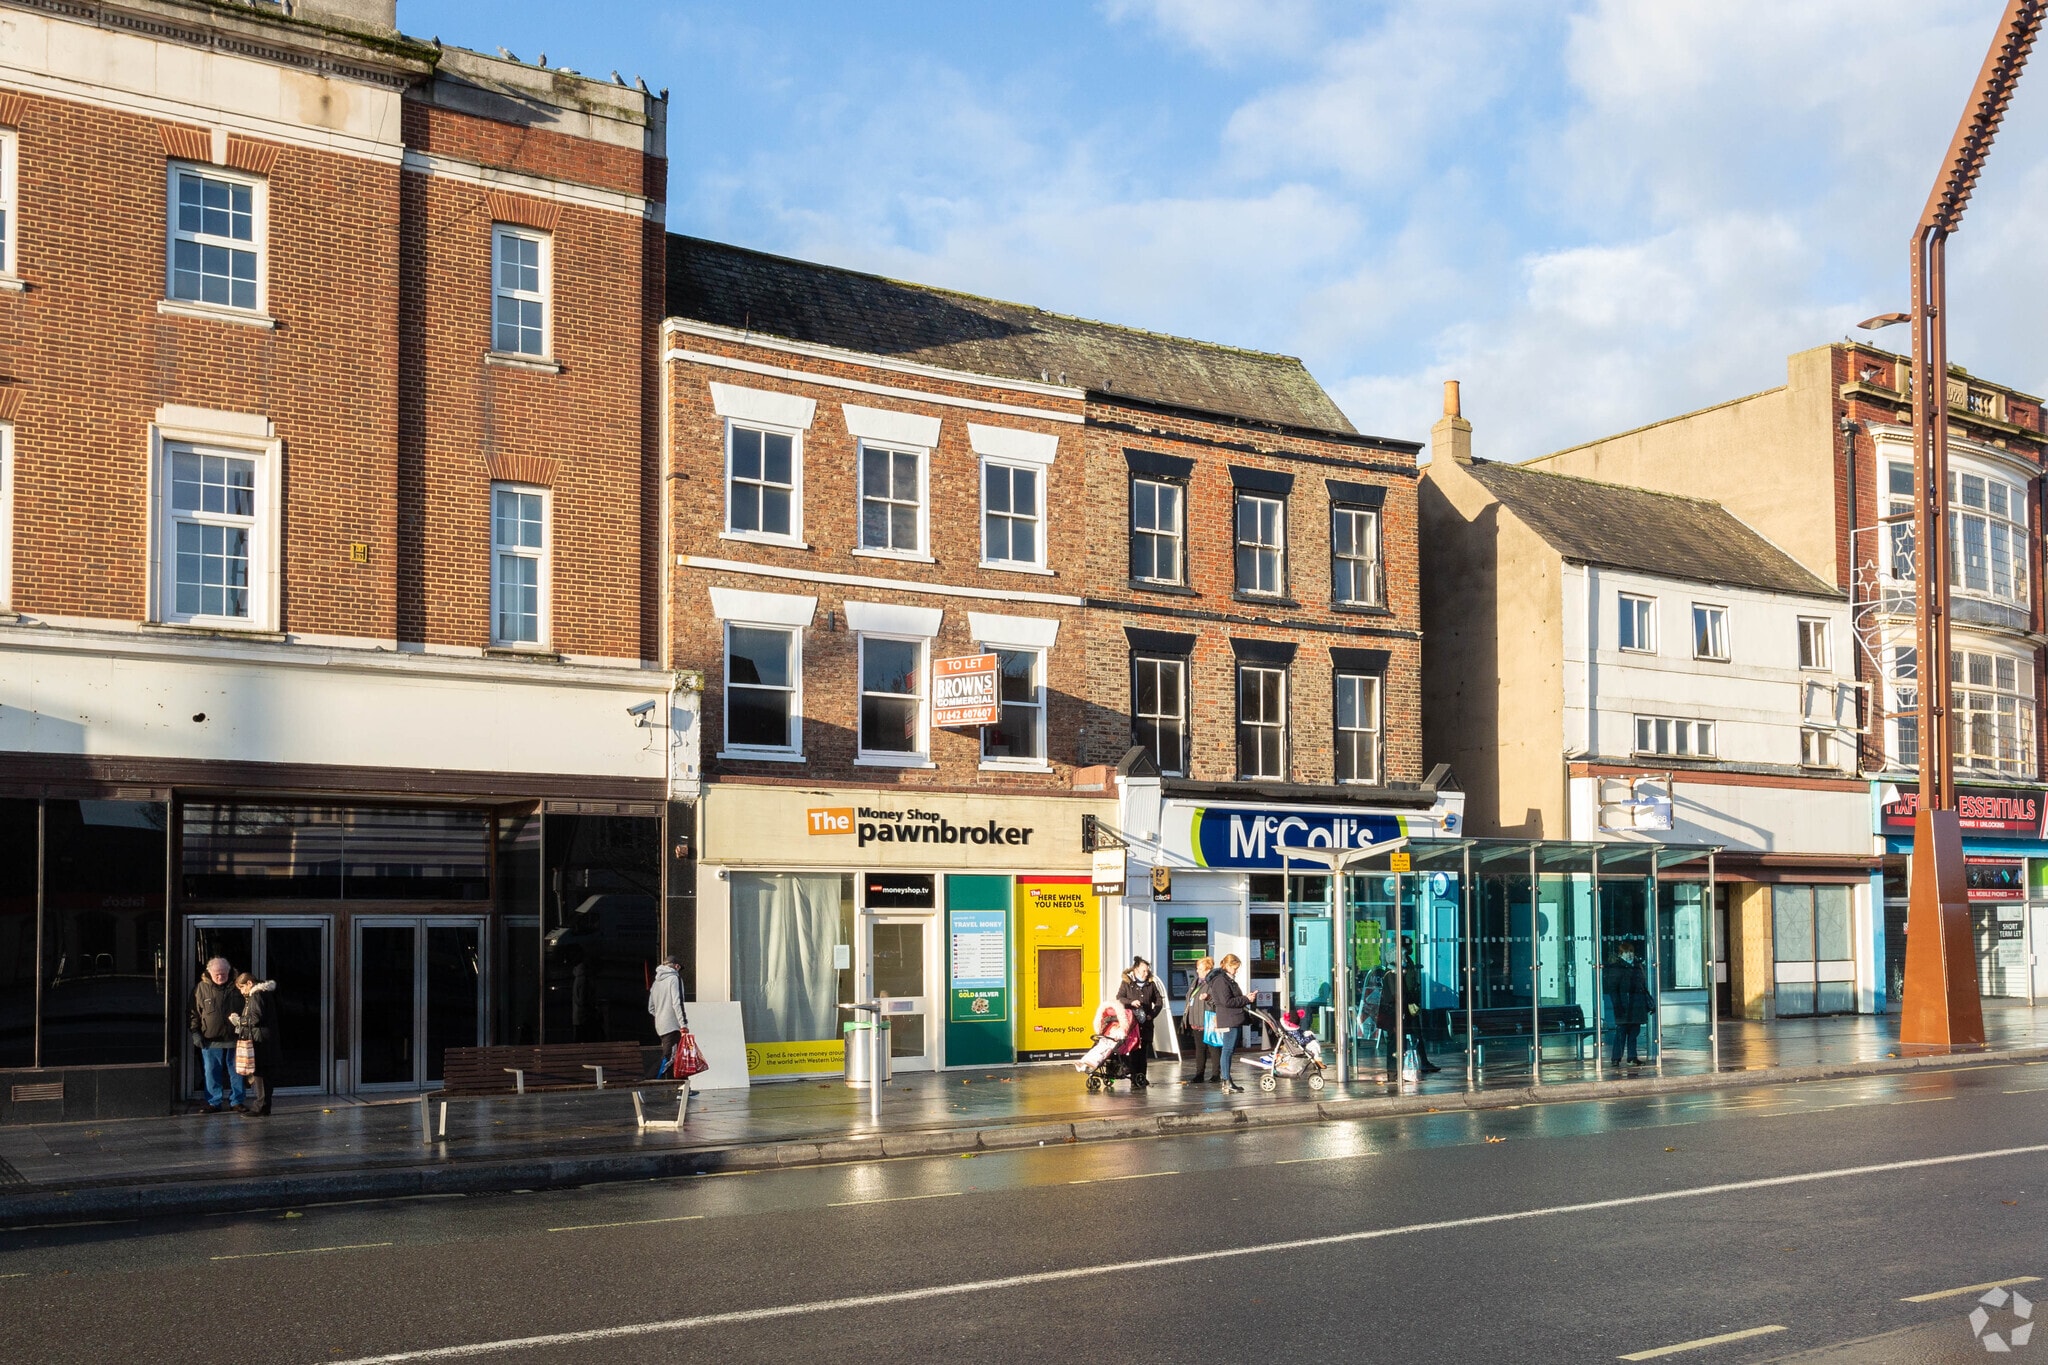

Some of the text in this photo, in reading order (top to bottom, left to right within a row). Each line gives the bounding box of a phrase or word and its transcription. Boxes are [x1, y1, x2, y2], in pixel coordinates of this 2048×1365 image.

[1947, 384, 1964, 405] 928
[947, 658, 983, 670] TO LET
[937, 675, 992, 699] BROWNS
[937, 695, 992, 707] COMMERCIAL
[937, 707, 992, 720] 01642 607607
[858, 807, 940, 823] Money Shop
[1959, 795, 2036, 820] ESSENTIALS
[811, 812, 849, 830] The
[858, 819, 1033, 847] pawnbroker
[1229, 814, 1373, 860] McColl's
[883, 886, 929, 895] moneyshop.tv
[1043, 1026, 1066, 1034] Money
[1067, 1026, 1084, 1034] Shop
